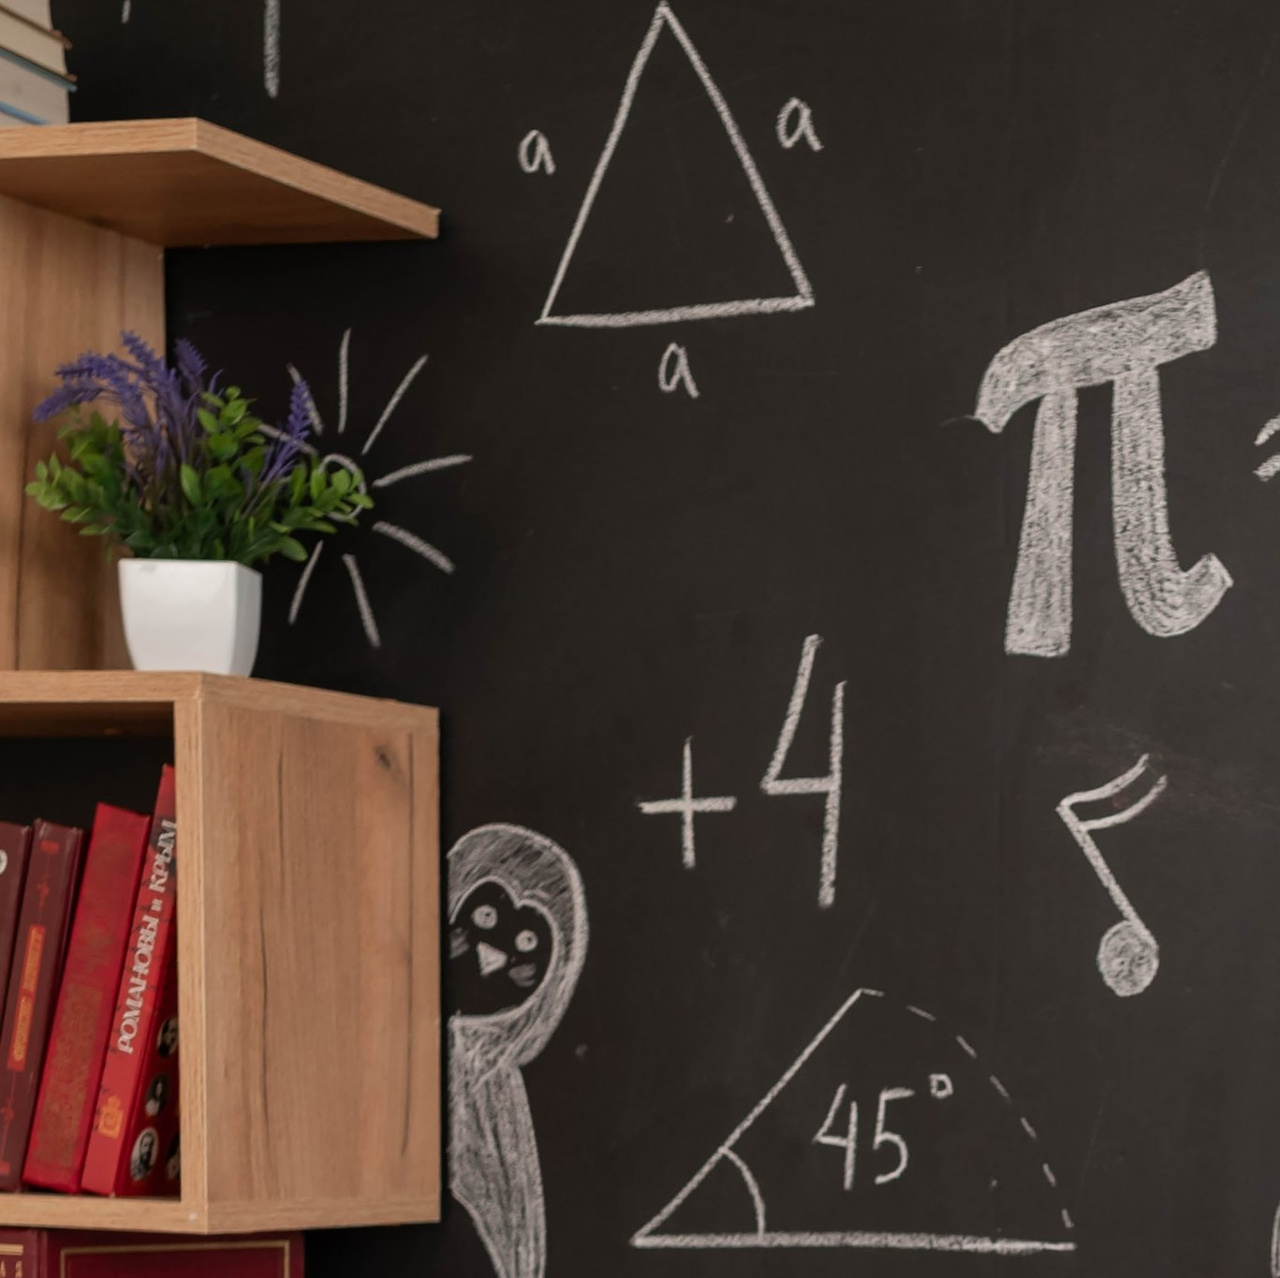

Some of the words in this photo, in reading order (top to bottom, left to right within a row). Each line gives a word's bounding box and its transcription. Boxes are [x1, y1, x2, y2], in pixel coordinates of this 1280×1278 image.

[518, 129, 556, 175] a
[776, 97, 823, 152] a
[658, 342, 700, 398] a
[117, 914, 160, 1055] РОМАНОВЫ
[148, 818, 178, 893] КРЫМ
